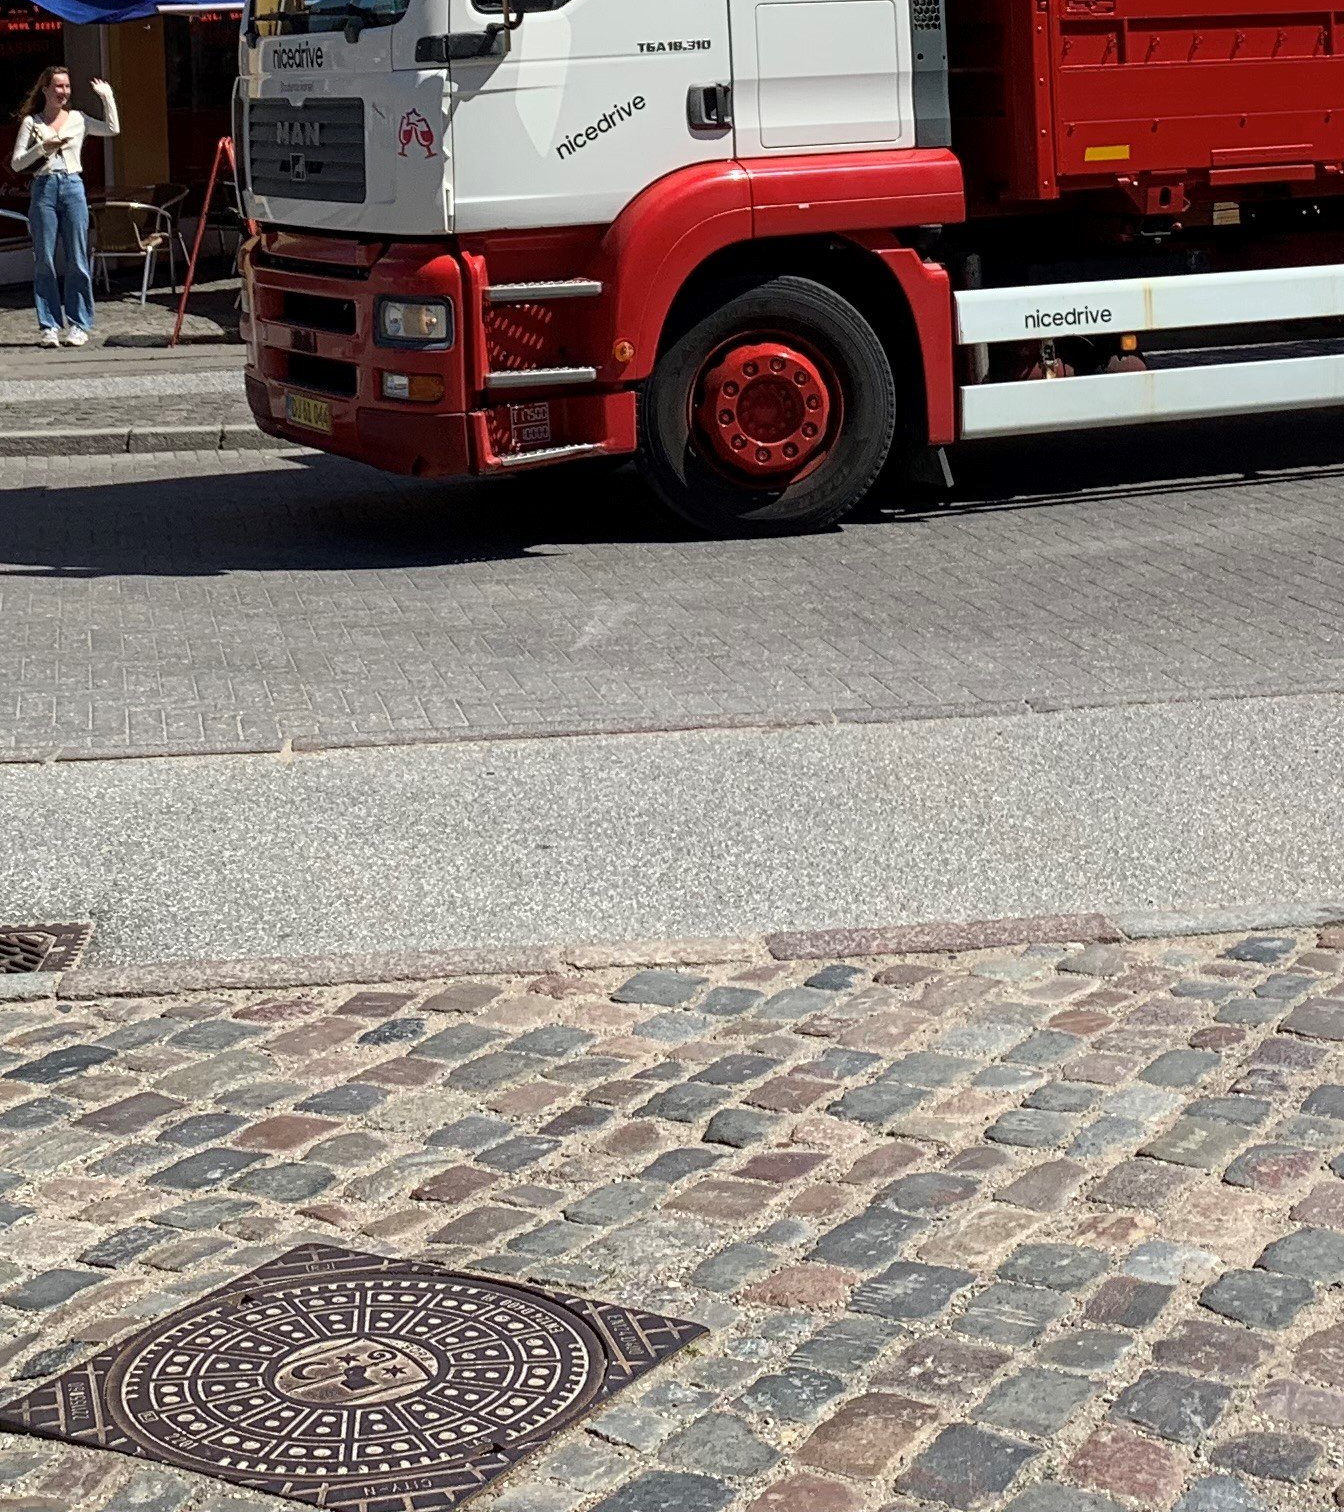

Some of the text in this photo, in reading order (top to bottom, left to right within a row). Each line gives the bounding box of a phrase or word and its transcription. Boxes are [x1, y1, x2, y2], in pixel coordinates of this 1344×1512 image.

[273, 40, 324, 69] nicedrive
[276, 121, 320, 146] MAN
[556, 95, 646, 160] nicedrive
[1024, 305, 1112, 329] nicedrive
